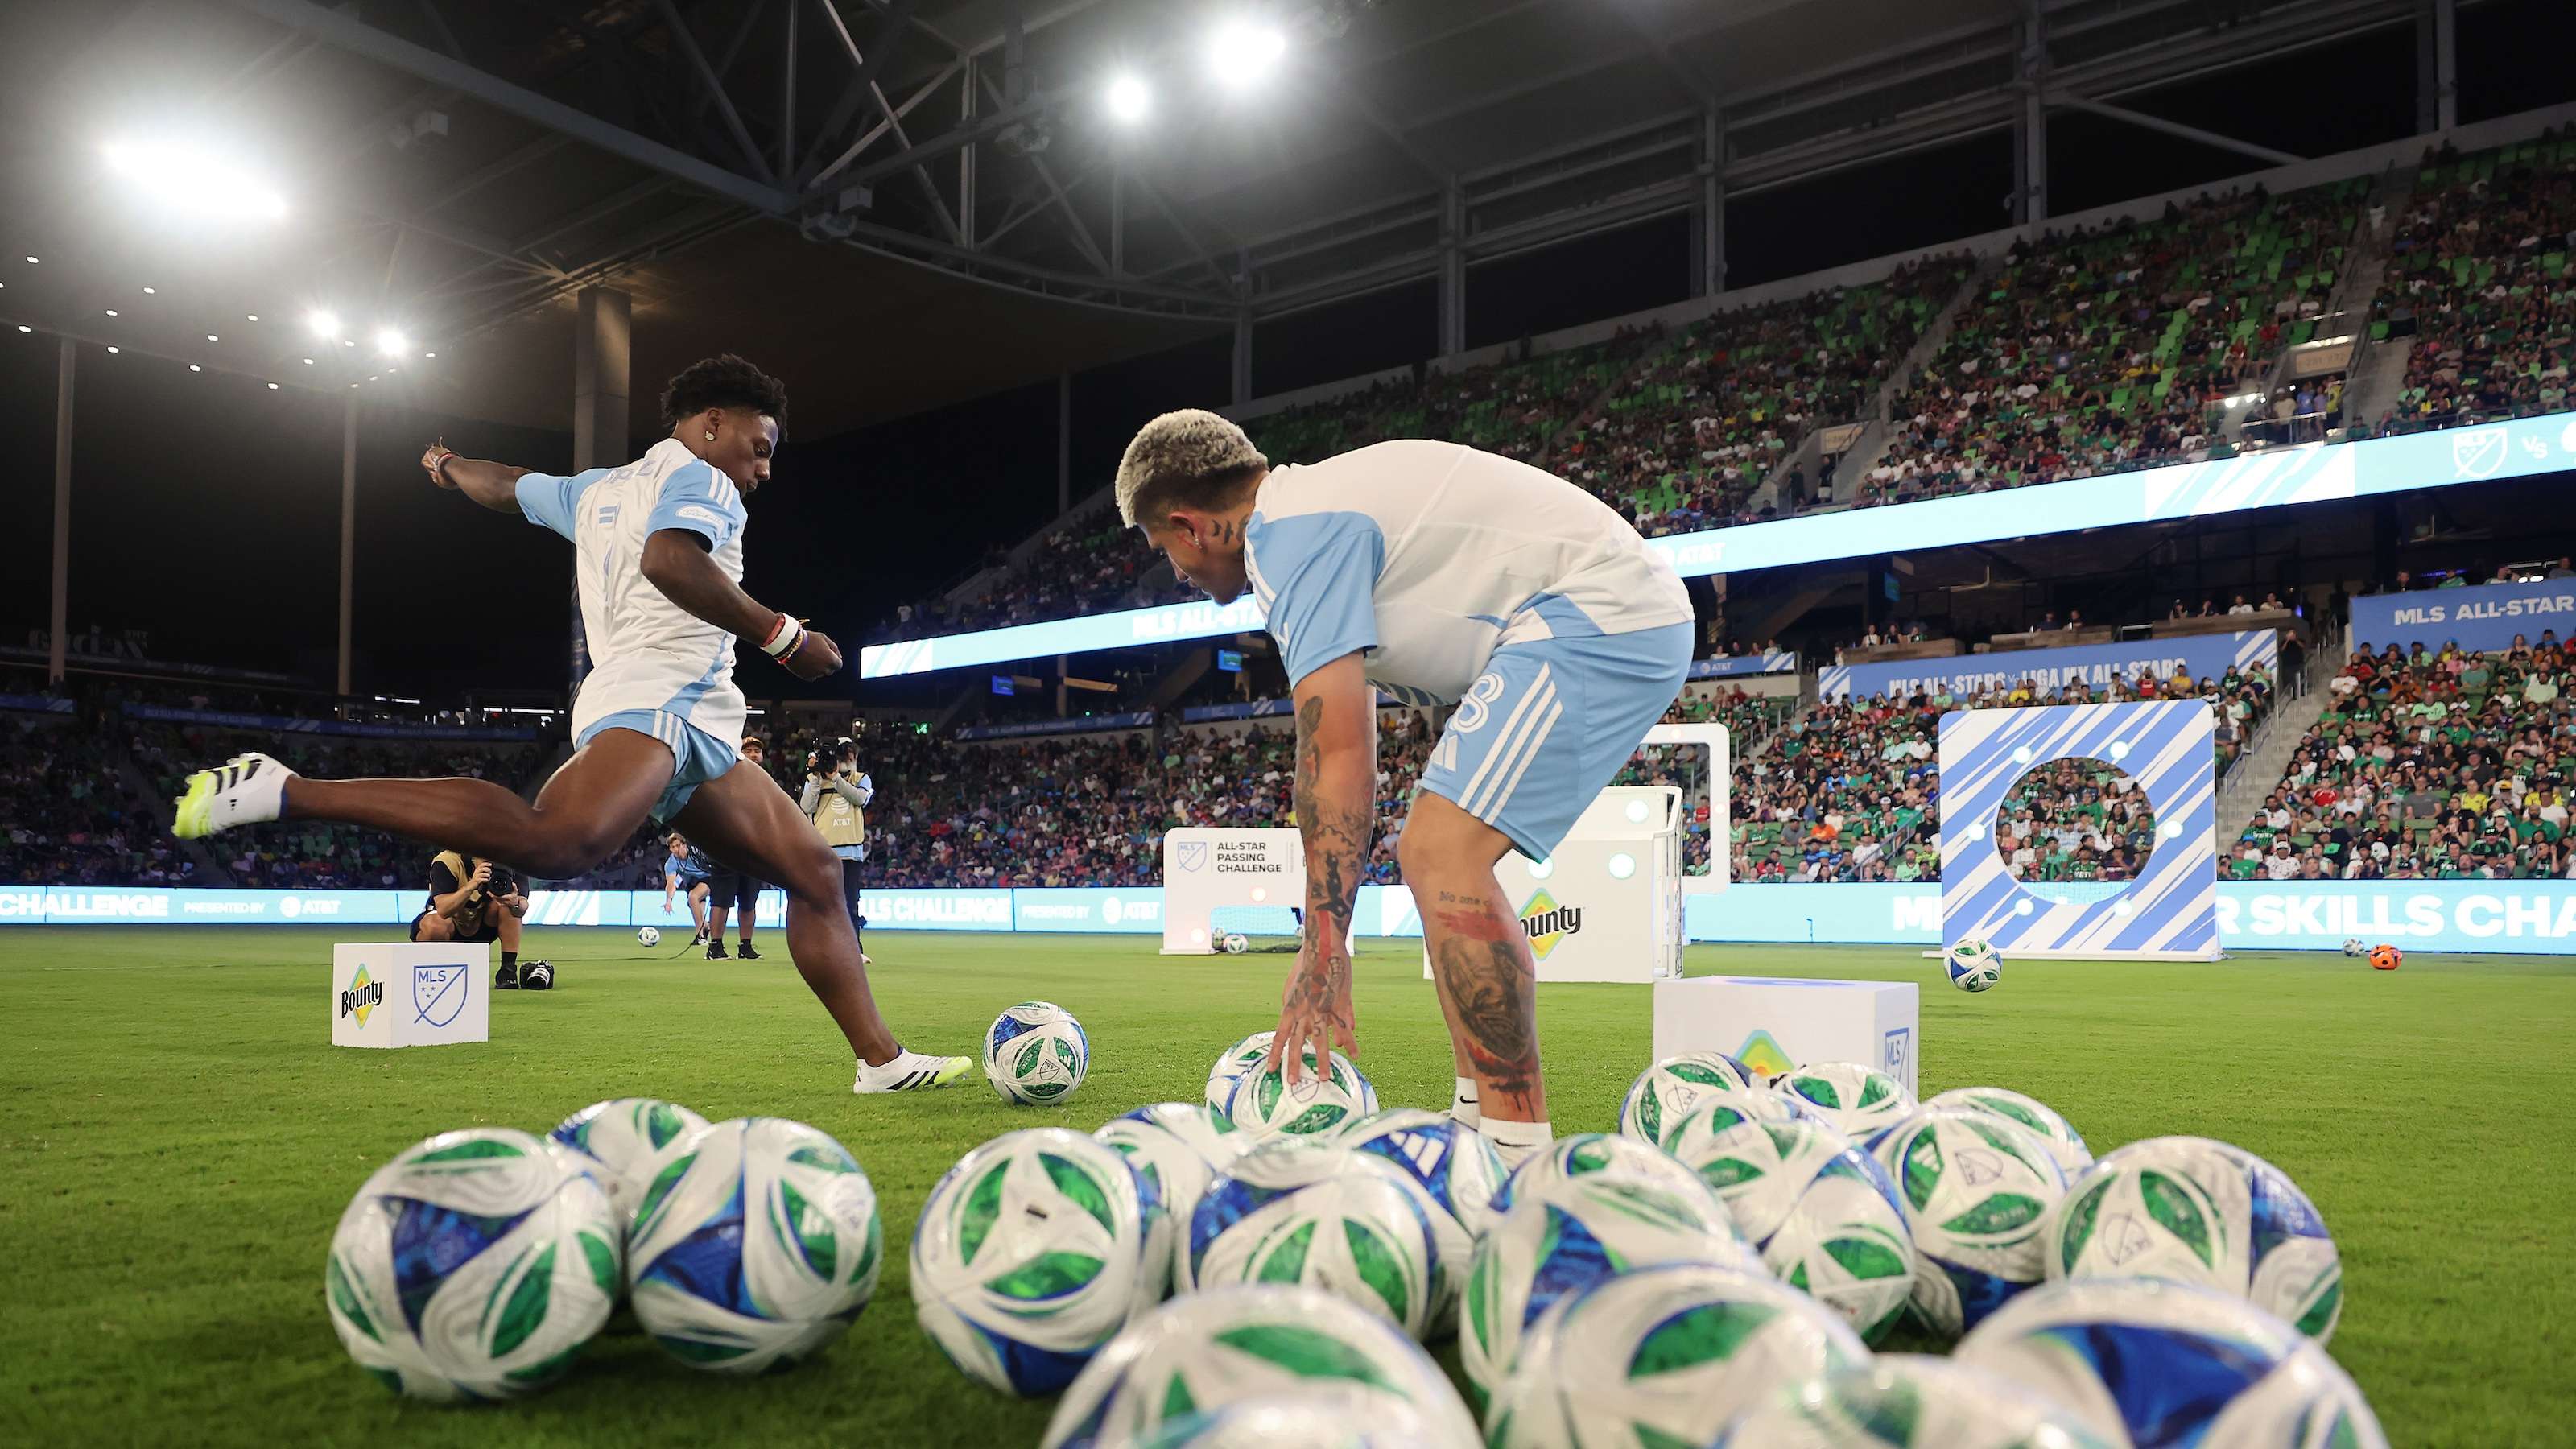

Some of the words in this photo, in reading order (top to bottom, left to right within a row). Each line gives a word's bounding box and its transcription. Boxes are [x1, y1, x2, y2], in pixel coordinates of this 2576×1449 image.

[2394, 605, 2446, 625] MLS
[2456, 595, 2575, 621] ALL-STAR
[1133, 610, 1177, 638] MLS
[832, 818, 851, 827] AT&T
[1217, 842, 1266, 851] ALL-STAR
[1217, 853, 1265, 861] PASSING
[1217, 864, 1282, 873] CHALLENGE
[0, 894, 169, 916] CHALLENGE
[894, 897, 1010, 923] CHALLENGE
[1122, 902, 1161, 921] AT&T
[2249, 895, 2445, 936] SKILLS
[418, 970, 446, 983] MLS
[341, 980, 382, 1019] Bounty
[1887, 1039, 1901, 1067] MLS
